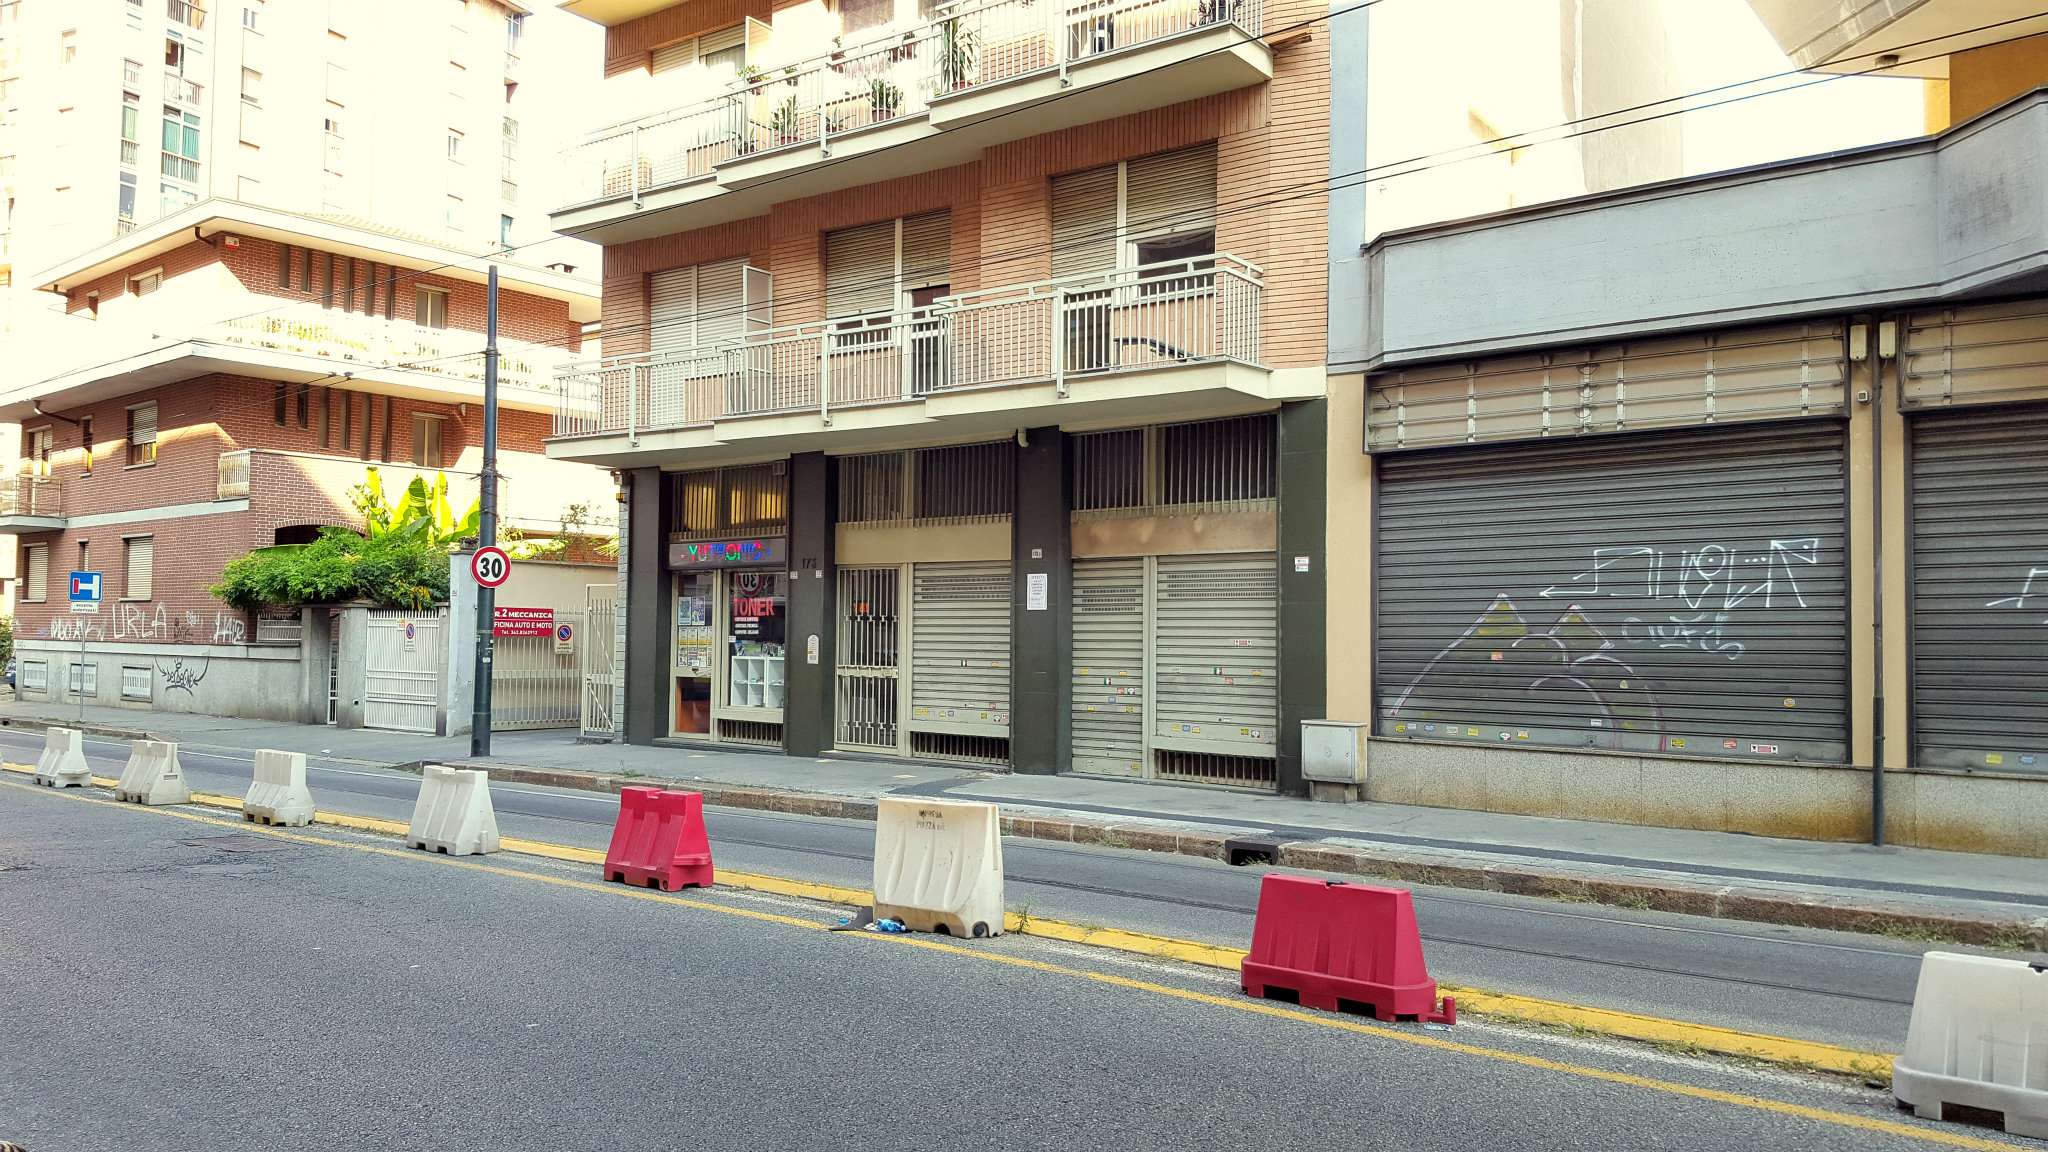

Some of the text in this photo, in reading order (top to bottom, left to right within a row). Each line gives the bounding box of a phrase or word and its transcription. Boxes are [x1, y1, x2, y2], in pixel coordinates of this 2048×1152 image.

[480, 557, 502, 578] 30
[733, 597, 774, 617] TONER
[113, 602, 166, 640] URLA
